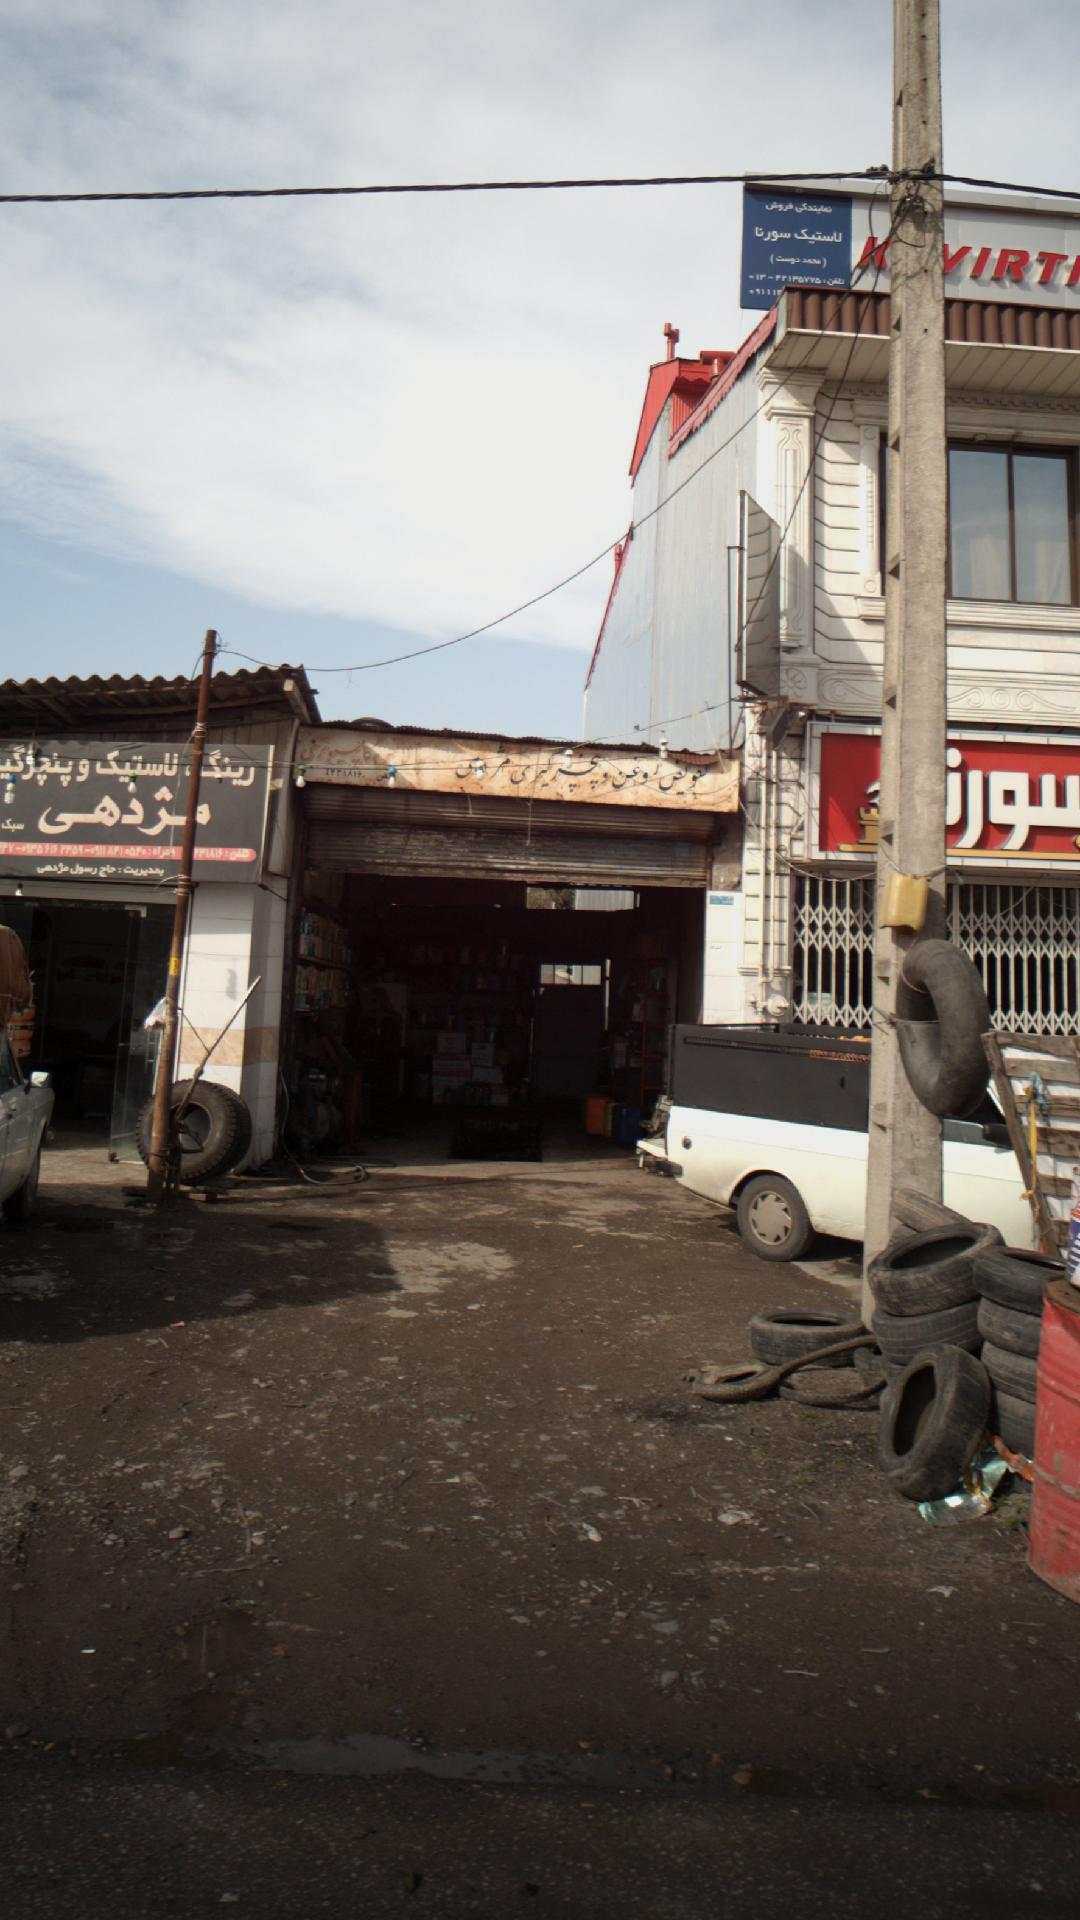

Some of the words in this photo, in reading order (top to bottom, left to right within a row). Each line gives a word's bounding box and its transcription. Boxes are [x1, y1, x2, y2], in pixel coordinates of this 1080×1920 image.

[765, 201, 794, 212] فروش
[795, 202, 833, 214] نمایندگی
[755, 226, 792, 242] سورنا
[794, 228, 843, 244] لاستیک
[76, 758, 90, 782] و
[95, 750, 179, 783] لاستیک
[36, 862, 70, 875] مژدهی
[69, 863, 98, 875] رسول
[98, 864, 116, 877] حاج
